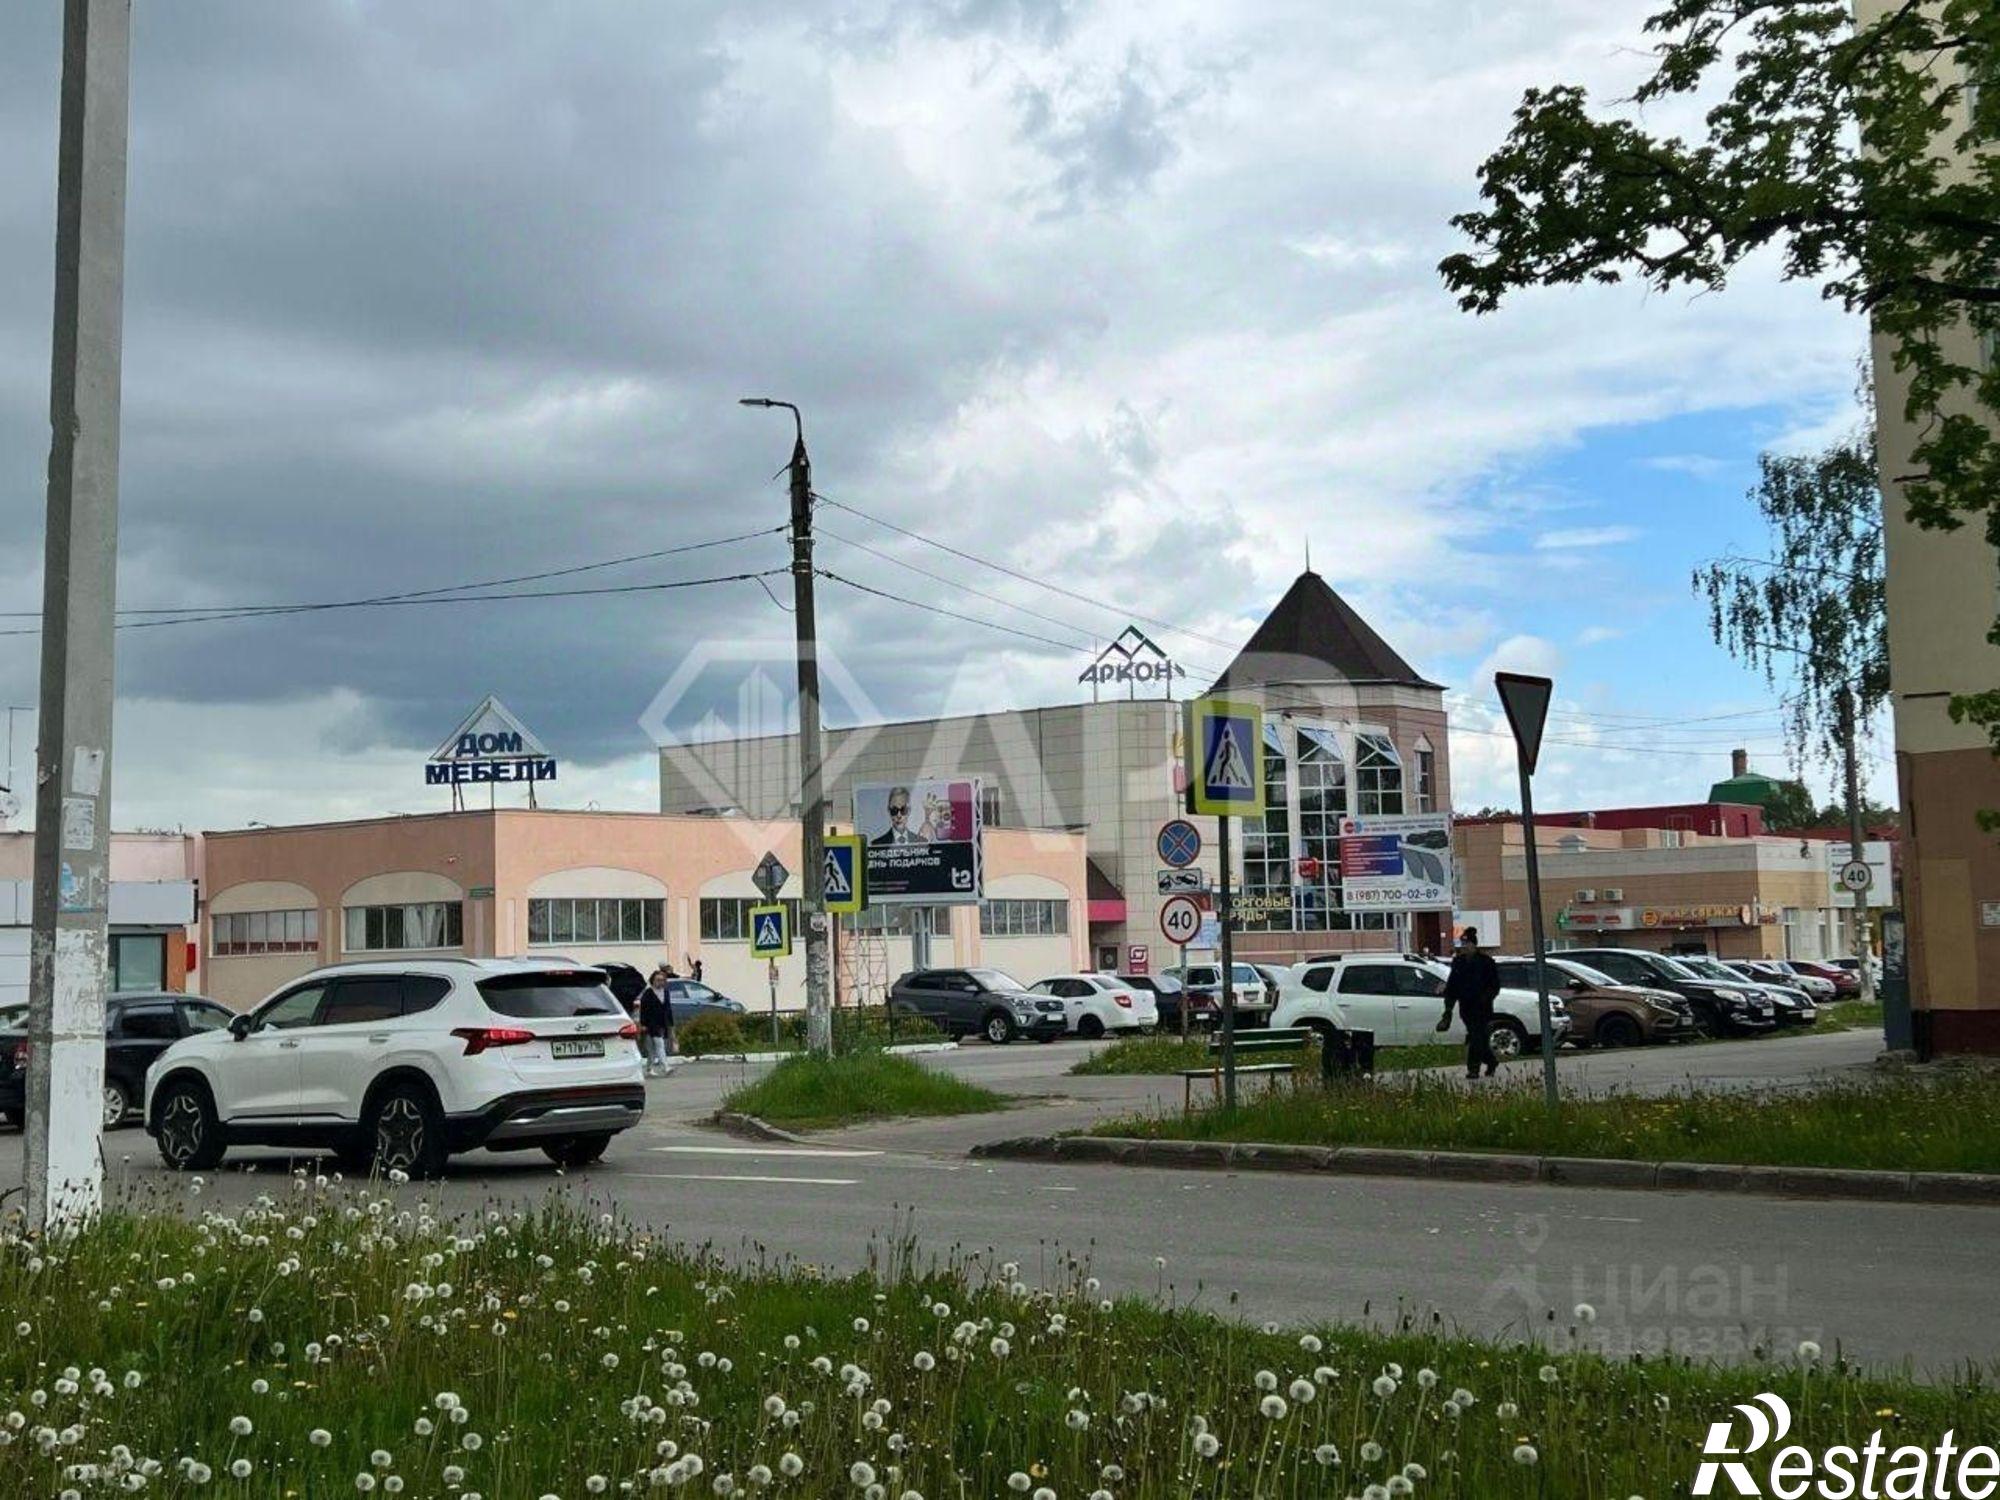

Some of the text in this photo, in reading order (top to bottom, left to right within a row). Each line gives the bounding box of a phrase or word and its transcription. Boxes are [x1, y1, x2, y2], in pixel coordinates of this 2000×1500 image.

[1079, 660, 1172, 684] АРКОН
[456, 732, 523, 757] ДОМ
[425, 760, 556, 784] МЕБЕЛИ
[867, 848, 930, 859] ОНЕДЕЛЬНИК
[889, 857, 940, 868] ПОДАРКОВ
[1847, 870, 1865, 882] 40
[1346, 888, 1439, 901] 8 (987) 700-02-89
[1232, 897, 1291, 908] ОРГОВЫЕ
[1167, 911, 1192, 930] 40
